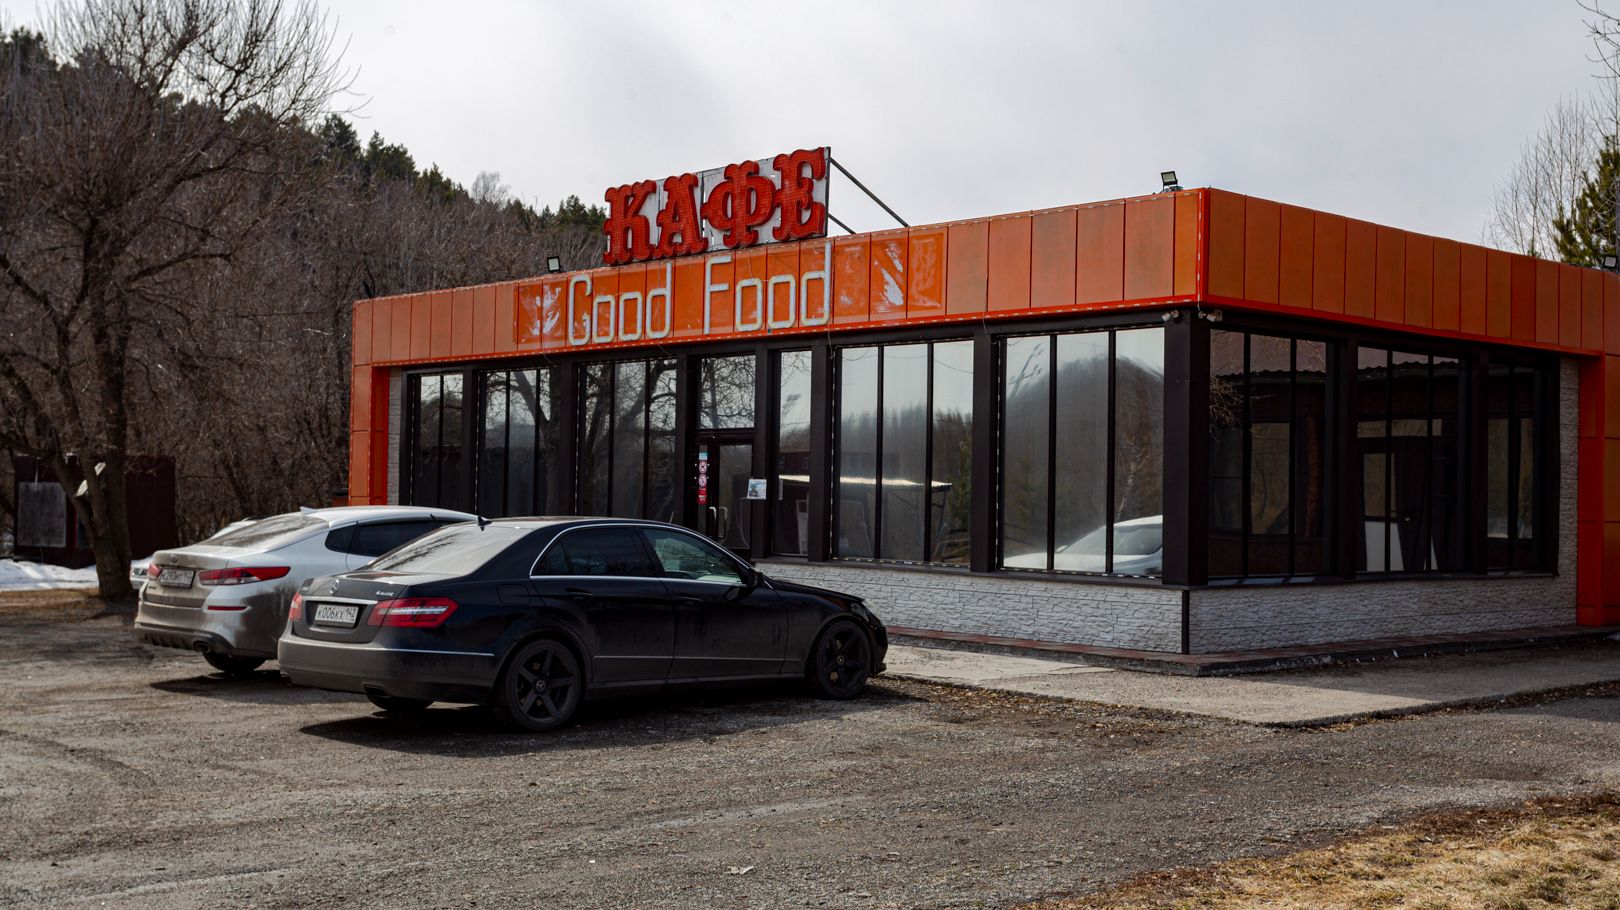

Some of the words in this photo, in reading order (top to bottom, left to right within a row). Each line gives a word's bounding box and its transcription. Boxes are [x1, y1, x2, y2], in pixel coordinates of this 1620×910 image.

[603, 147, 826, 266] КАФЕ
[568, 262, 672, 346] Good
[704, 241, 832, 335] Food
